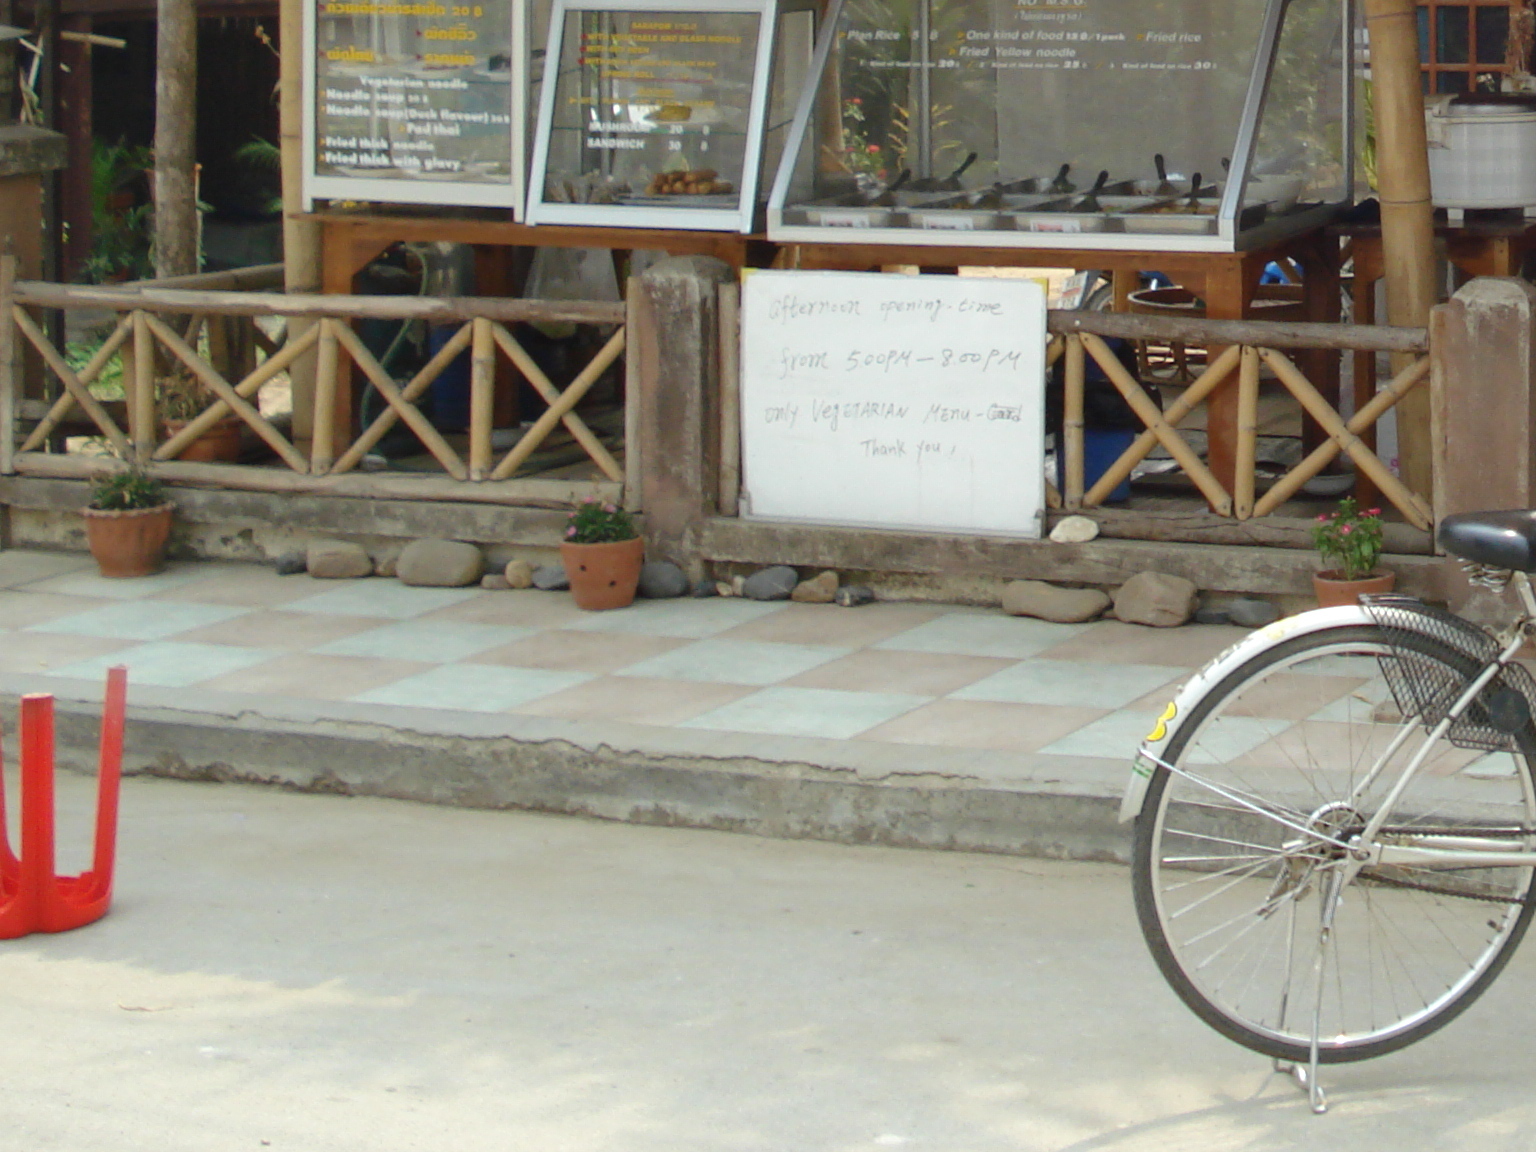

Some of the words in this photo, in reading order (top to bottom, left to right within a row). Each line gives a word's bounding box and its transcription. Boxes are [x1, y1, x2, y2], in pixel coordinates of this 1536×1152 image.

[452, 6, 469, 16] 20
[874, 29, 902, 40] Rice
[966, 29, 991, 40] One
[993, 29, 1020, 40] kind
[1022, 30, 1034, 41] of
[1036, 30, 1063, 42] food
[1146, 31, 1177, 44] Fried
[959, 46, 990, 58] Fried
[994, 47, 1032, 58] Yellow
[1035, 47, 1076, 58] noodle
[938, 59, 955, 68] 20
[360, 76, 424, 89] Vegetarian
[427, 78, 468, 90] noodle
[326, 88, 370, 100] Noodle
[375, 92, 404, 104] soup
[326, 103, 370, 116] Noodle
[406, 122, 431, 135] Pad
[325, 136, 357, 148] Fried
[587, 137, 646, 150] SANDWICH
[325, 151, 357, 164] Fried
[957, 298, 1004, 315] time
[778, 347, 829, 380] from
[860, 438, 906, 458] Thank
